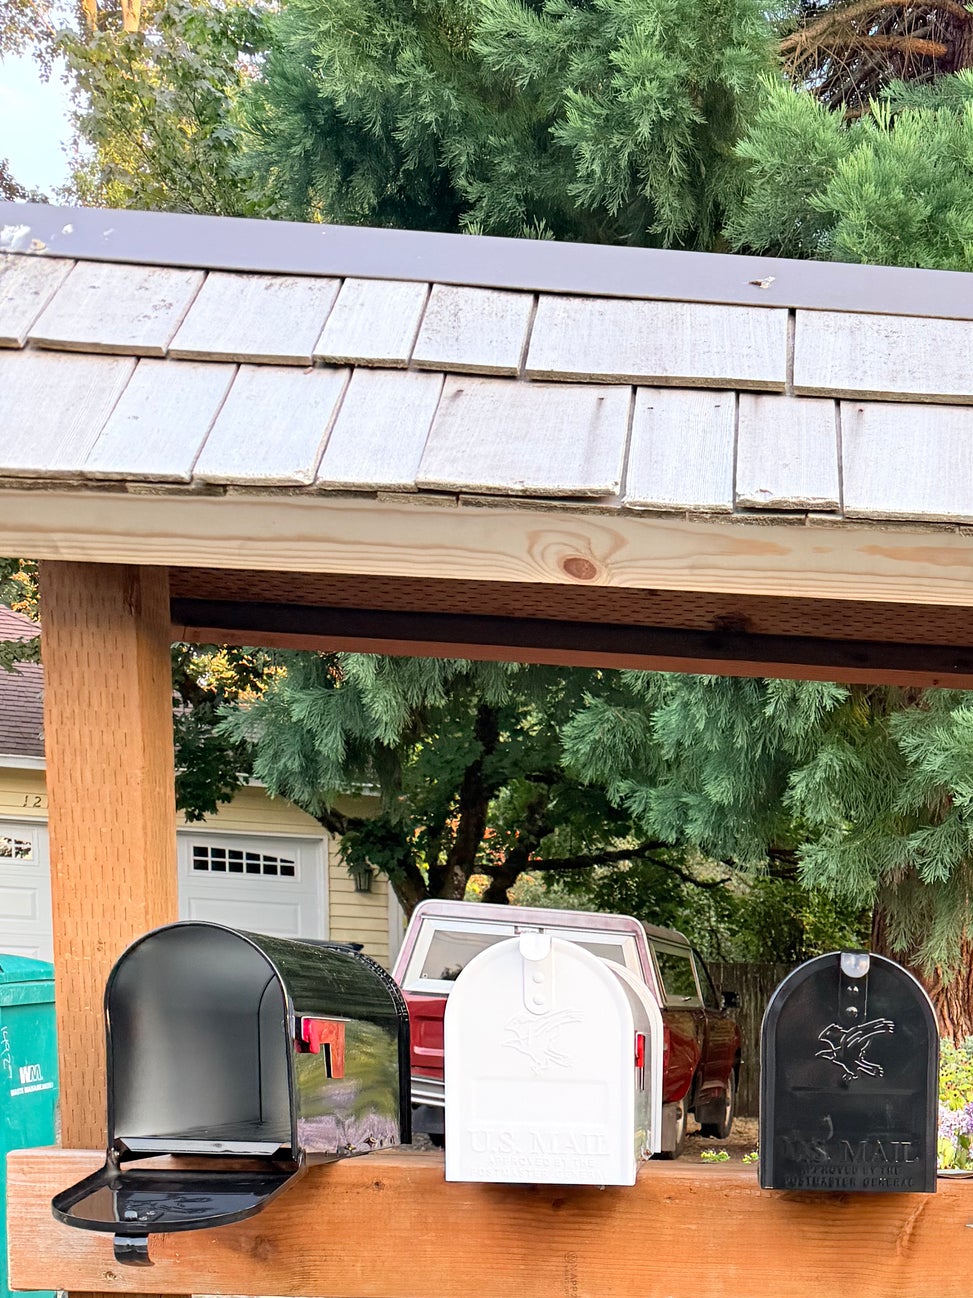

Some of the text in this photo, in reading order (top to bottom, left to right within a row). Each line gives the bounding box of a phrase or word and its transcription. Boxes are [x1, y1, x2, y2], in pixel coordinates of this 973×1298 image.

[468, 1129, 611, 1157] U.S. MAIL
[841, 1139, 919, 1163] MAIL
